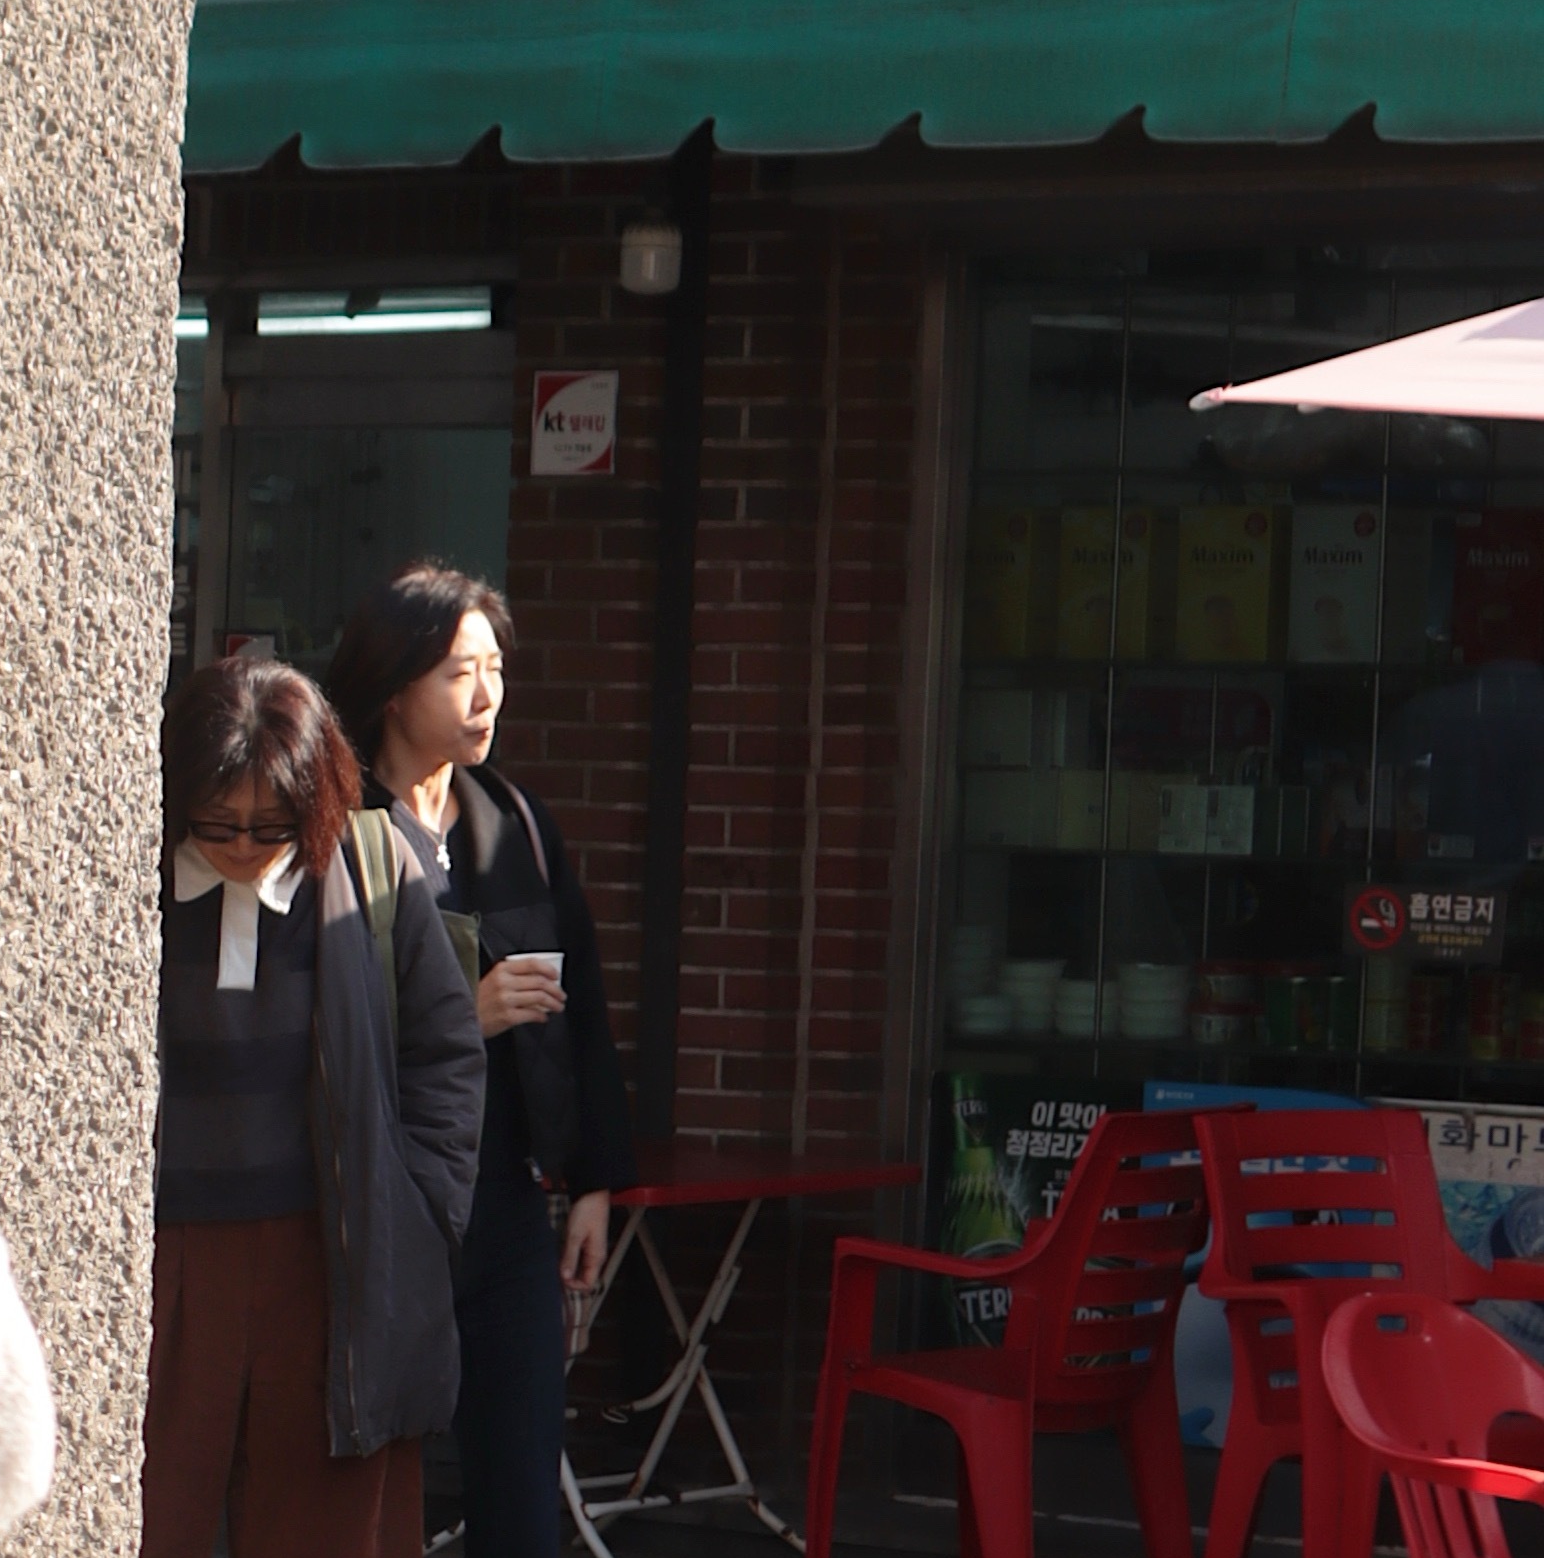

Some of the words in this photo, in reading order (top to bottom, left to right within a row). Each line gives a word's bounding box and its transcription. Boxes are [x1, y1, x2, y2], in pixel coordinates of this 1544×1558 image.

[1409, 892, 1495, 924] 흡연금지
[1031, 1100, 1056, 1128] 이
[959, 1286, 1013, 1325] TER
